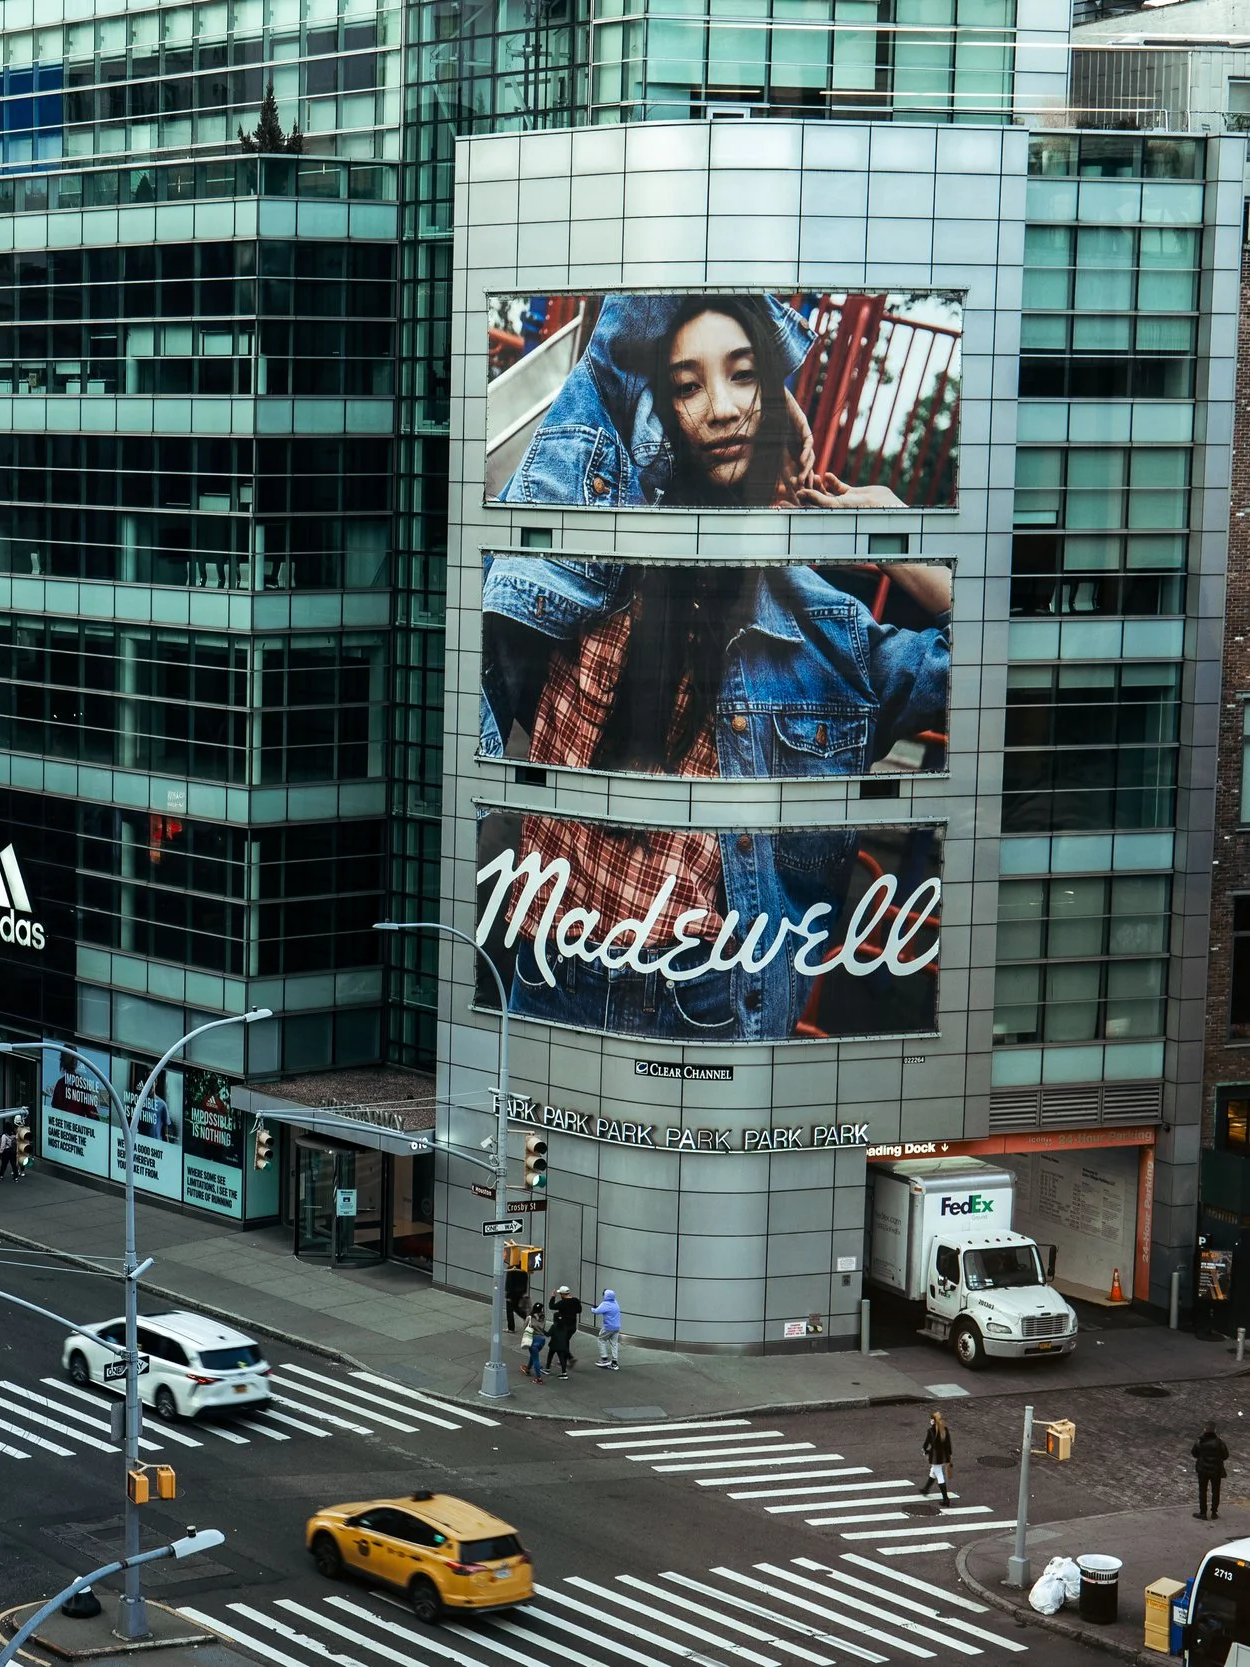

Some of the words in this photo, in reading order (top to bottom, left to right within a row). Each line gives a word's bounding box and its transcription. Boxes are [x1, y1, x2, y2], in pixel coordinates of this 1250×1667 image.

[476, 848, 941, 988] Madewell
[65, 1072, 99, 1093] IMPOSSIBLE
[649, 1063, 682, 1078] CLEAR
[683, 1066, 732, 1081] CHANNEL
[65, 1086, 71, 1100] IS
[71, 1089, 99, 1107] NOTHING
[124, 1090, 159, 1112] IMPOSIBLE
[48, 1116, 55, 1126] WE
[55, 1118, 63, 1128] SEE
[63, 1120, 72, 1131] THE
[72, 1122, 95, 1138] BEAUTIFUL
[191, 1107, 232, 1130] IMPOSSIBLE
[543, 1105, 588, 1135] PARK
[597, 1118, 652, 1145] PARK
[666, 1127, 731, 1150] PARK
[744, 1126, 802, 1150] PARK
[814, 1123, 869, 1146] PARK
[48, 1126, 60, 1138] GAME
[60, 1129, 78, 1143] BECOME
[78, 1135, 87, 1146] THE
[192, 1122, 199, 1137] IS
[200, 1125, 231, 1147] NOTHING
[1108, 1130, 1152, 1145] Parking
[48, 1137, 60, 1149] MOST
[60, 1140, 84, 1157] ACCEPTING.
[117, 1138, 124, 1148] WE
[138, 1144, 150, 1156] GOOD
[151, 1148, 163, 1160] SHOT
[866, 1144, 902, 1157] ading
[905, 1142, 936, 1155] Dock
[139, 1166, 144, 1175] IT
[145, 1168, 159, 1180] FROM.
[187, 1166, 203, 1179] WHERE
[203, 1170, 216, 1183] SOME
[217, 1174, 226, 1186] SEE
[219, 1187, 228, 1197] SEE
[228, 1189, 238, 1200] THE
[1145, 1160, 1154, 1210] Parking
[187, 1187, 204, 1200] FUTURE
[204, 1192, 211, 1202] OF
[211, 1194, 232, 1209] RUNNING
[507, 1203, 528, 1213] Crosby
[530, 1202, 536, 1210] St
[940, 1194, 994, 1216] FedEx
[1142, 1211, 1151, 1263] 24-Hour
[1198, 1236, 1207, 1246] P
[1214, 1567, 1233, 1581] 2713
